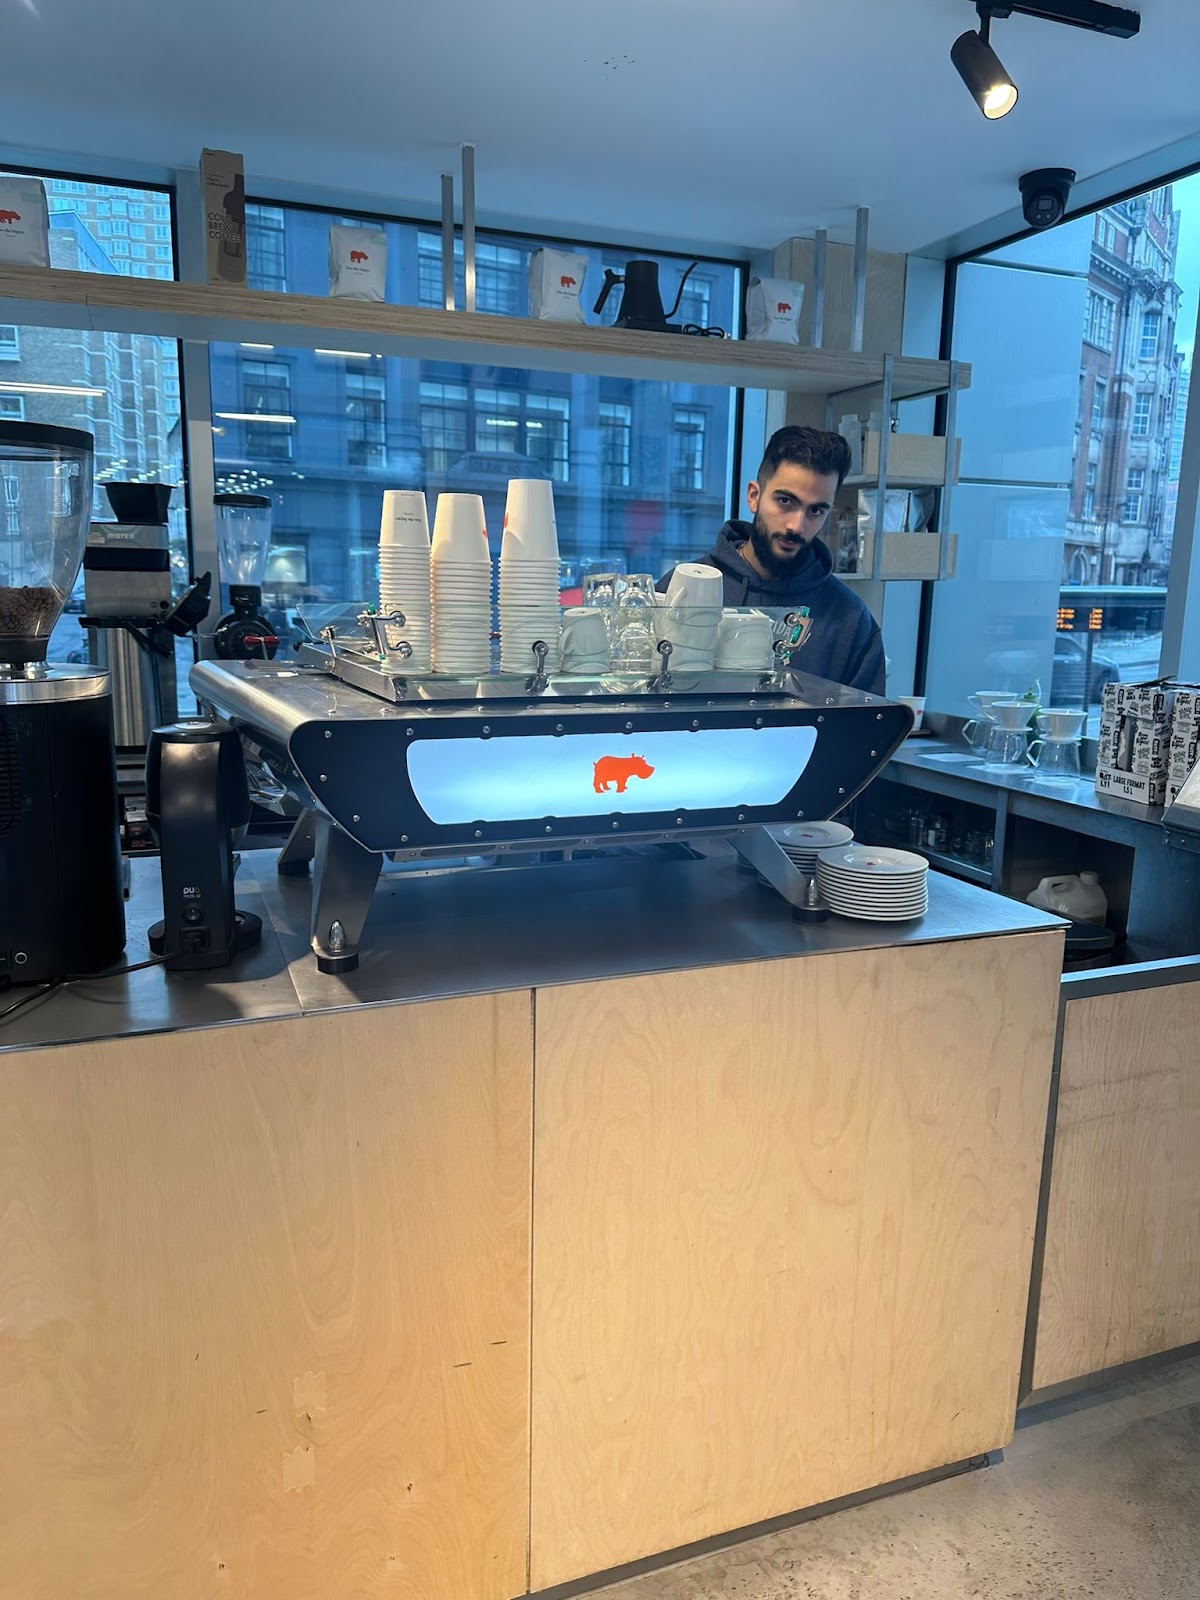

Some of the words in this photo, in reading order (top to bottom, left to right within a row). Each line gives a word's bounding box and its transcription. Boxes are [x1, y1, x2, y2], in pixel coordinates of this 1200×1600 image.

[208, 222, 232, 230] BREW
[209, 230, 240, 242] COFFEE
[1113, 776, 1126, 785] LARGE
[1127, 778, 1146, 790] FORMAT
